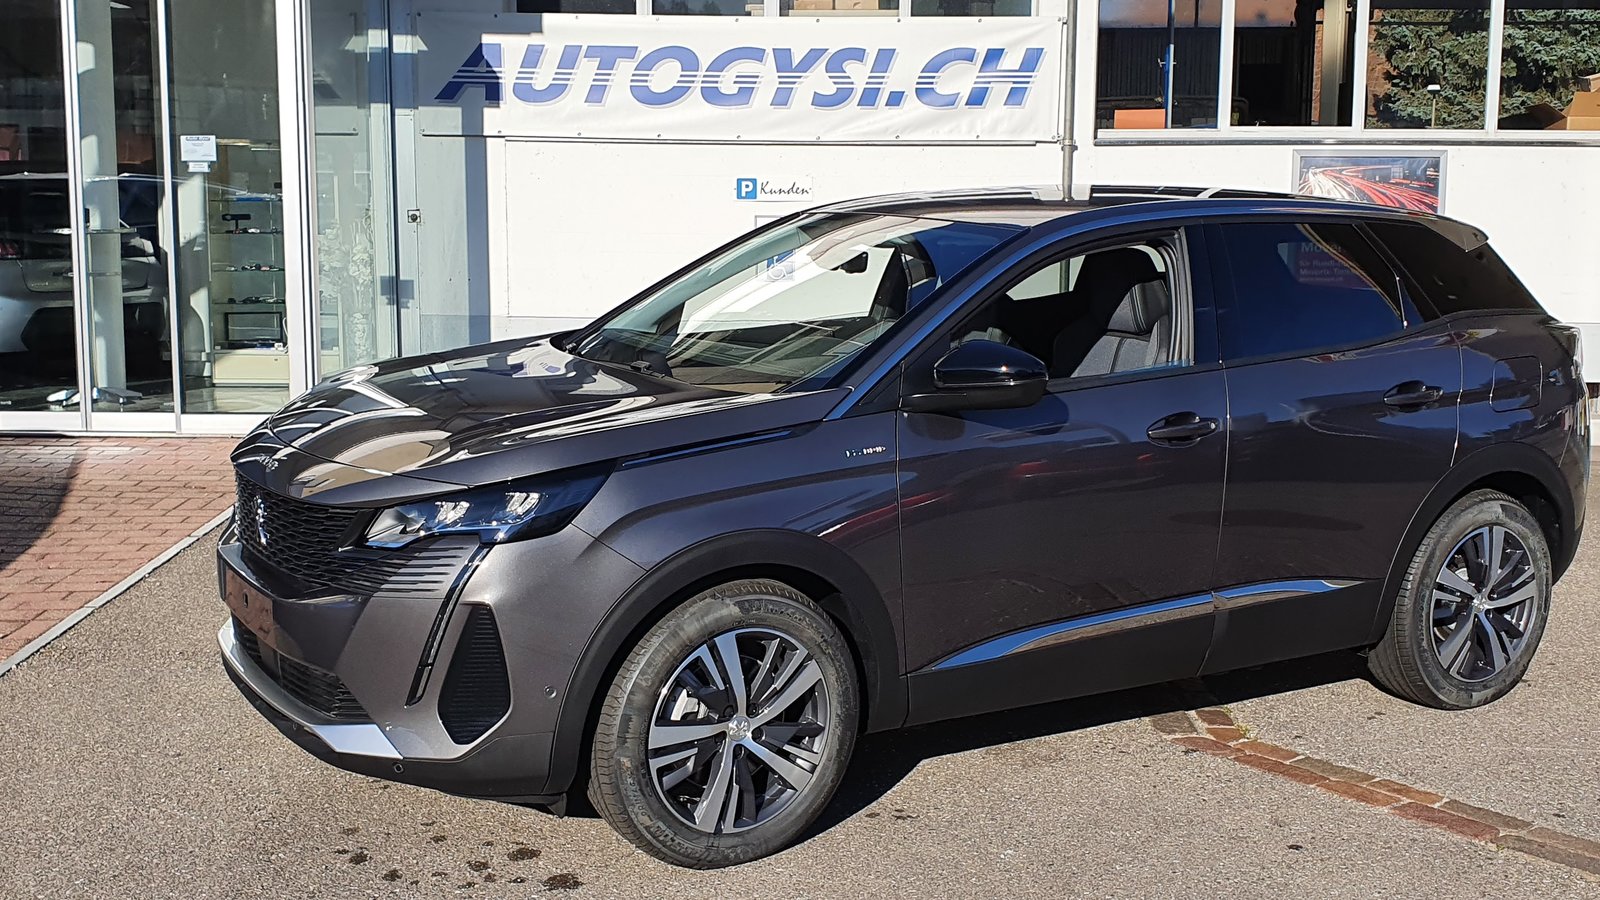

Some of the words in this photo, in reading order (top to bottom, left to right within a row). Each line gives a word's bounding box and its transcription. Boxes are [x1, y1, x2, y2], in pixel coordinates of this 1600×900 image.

[434, 43, 1045, 108] AUTOGYSI.CH
[741, 180, 754, 198] P
[760, 180, 809, 195] Kunden
